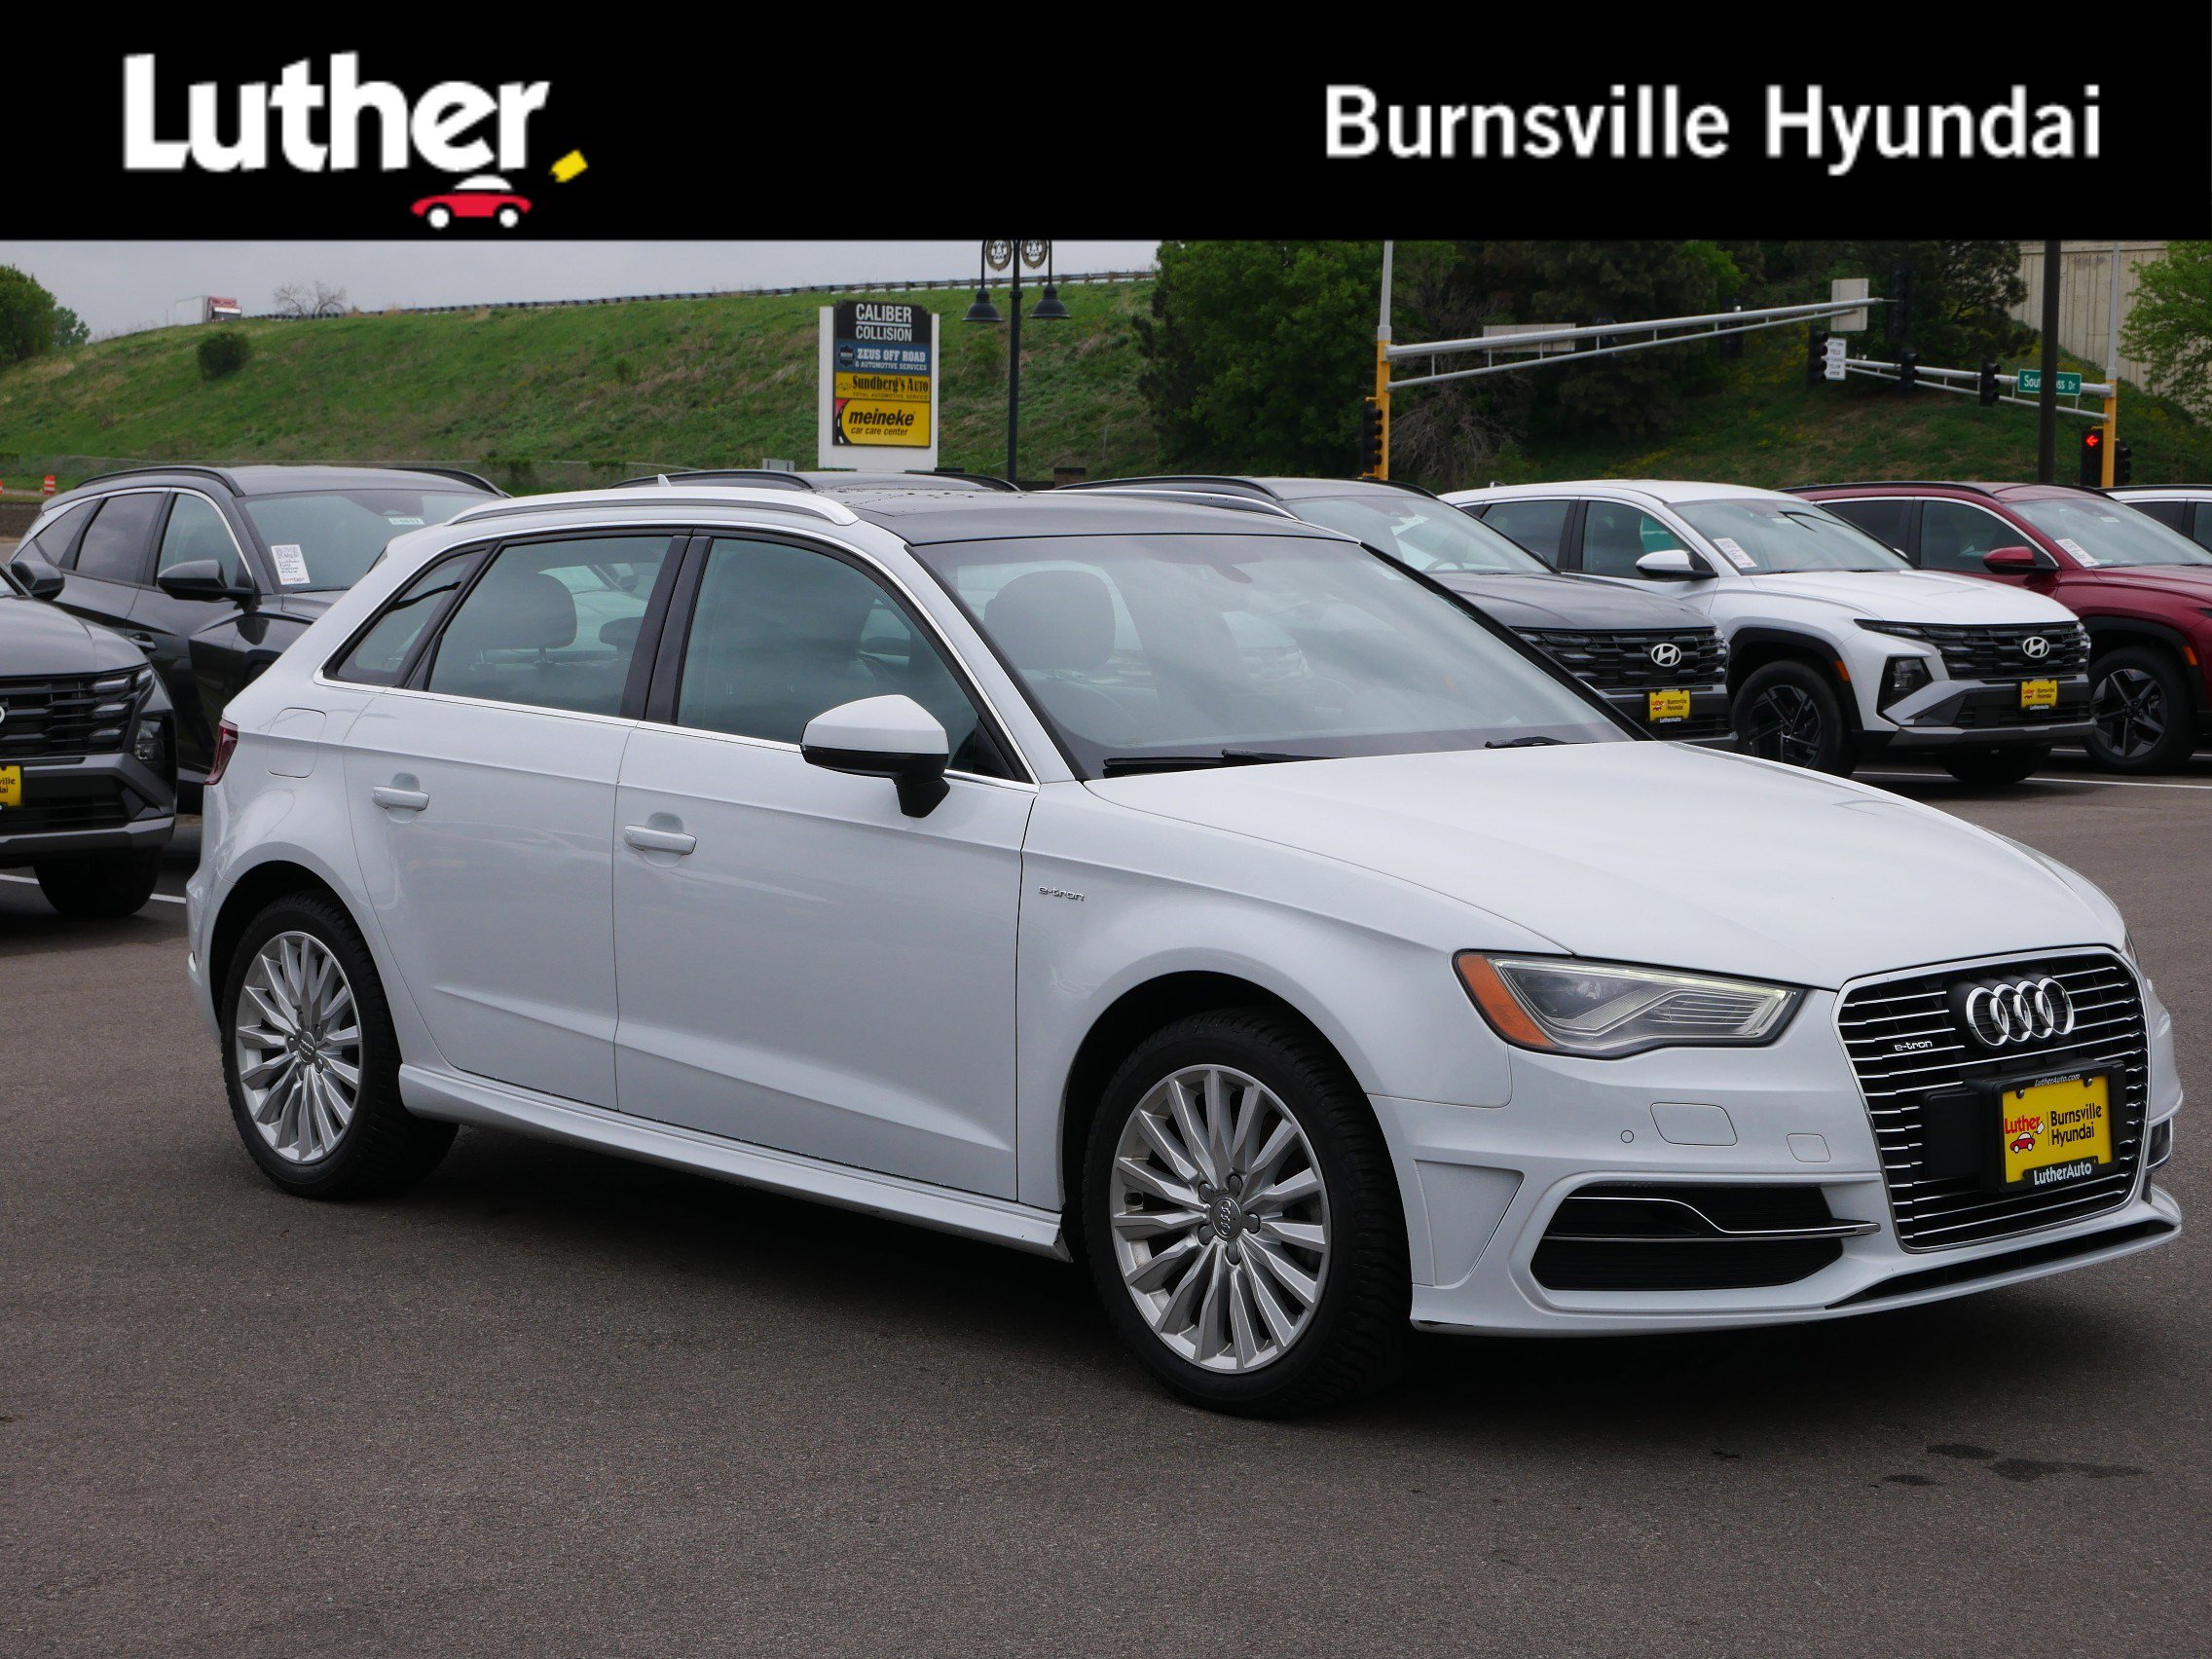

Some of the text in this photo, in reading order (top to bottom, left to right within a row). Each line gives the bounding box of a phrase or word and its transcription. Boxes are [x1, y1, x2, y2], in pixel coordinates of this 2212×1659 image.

[856, 303, 912, 323] CALIBER
[856, 325, 912, 342] COLLISION
[857, 348, 881, 360] ZEUS
[883, 350, 901, 361] OFF
[902, 350, 926, 362] ROAD
[861, 361, 898, 370] AUTOMOTIVE
[853, 375, 905, 392] Sundberg's
[2068, 380, 2077, 389] Dr
[849, 408, 914, 426] meineke
[884, 427, 908, 436] center
[1038, 886, 1086, 902] e-tron
[1894, 1040, 1934, 1051] e-tron
[2034, 1073, 2081, 1088] LutherAuto.com
[2004, 1102, 2102, 1135] Luther Burnsville
[2051, 1122, 2095, 1147] Hyundai
[2033, 1161, 2092, 1186] LutherAuto
